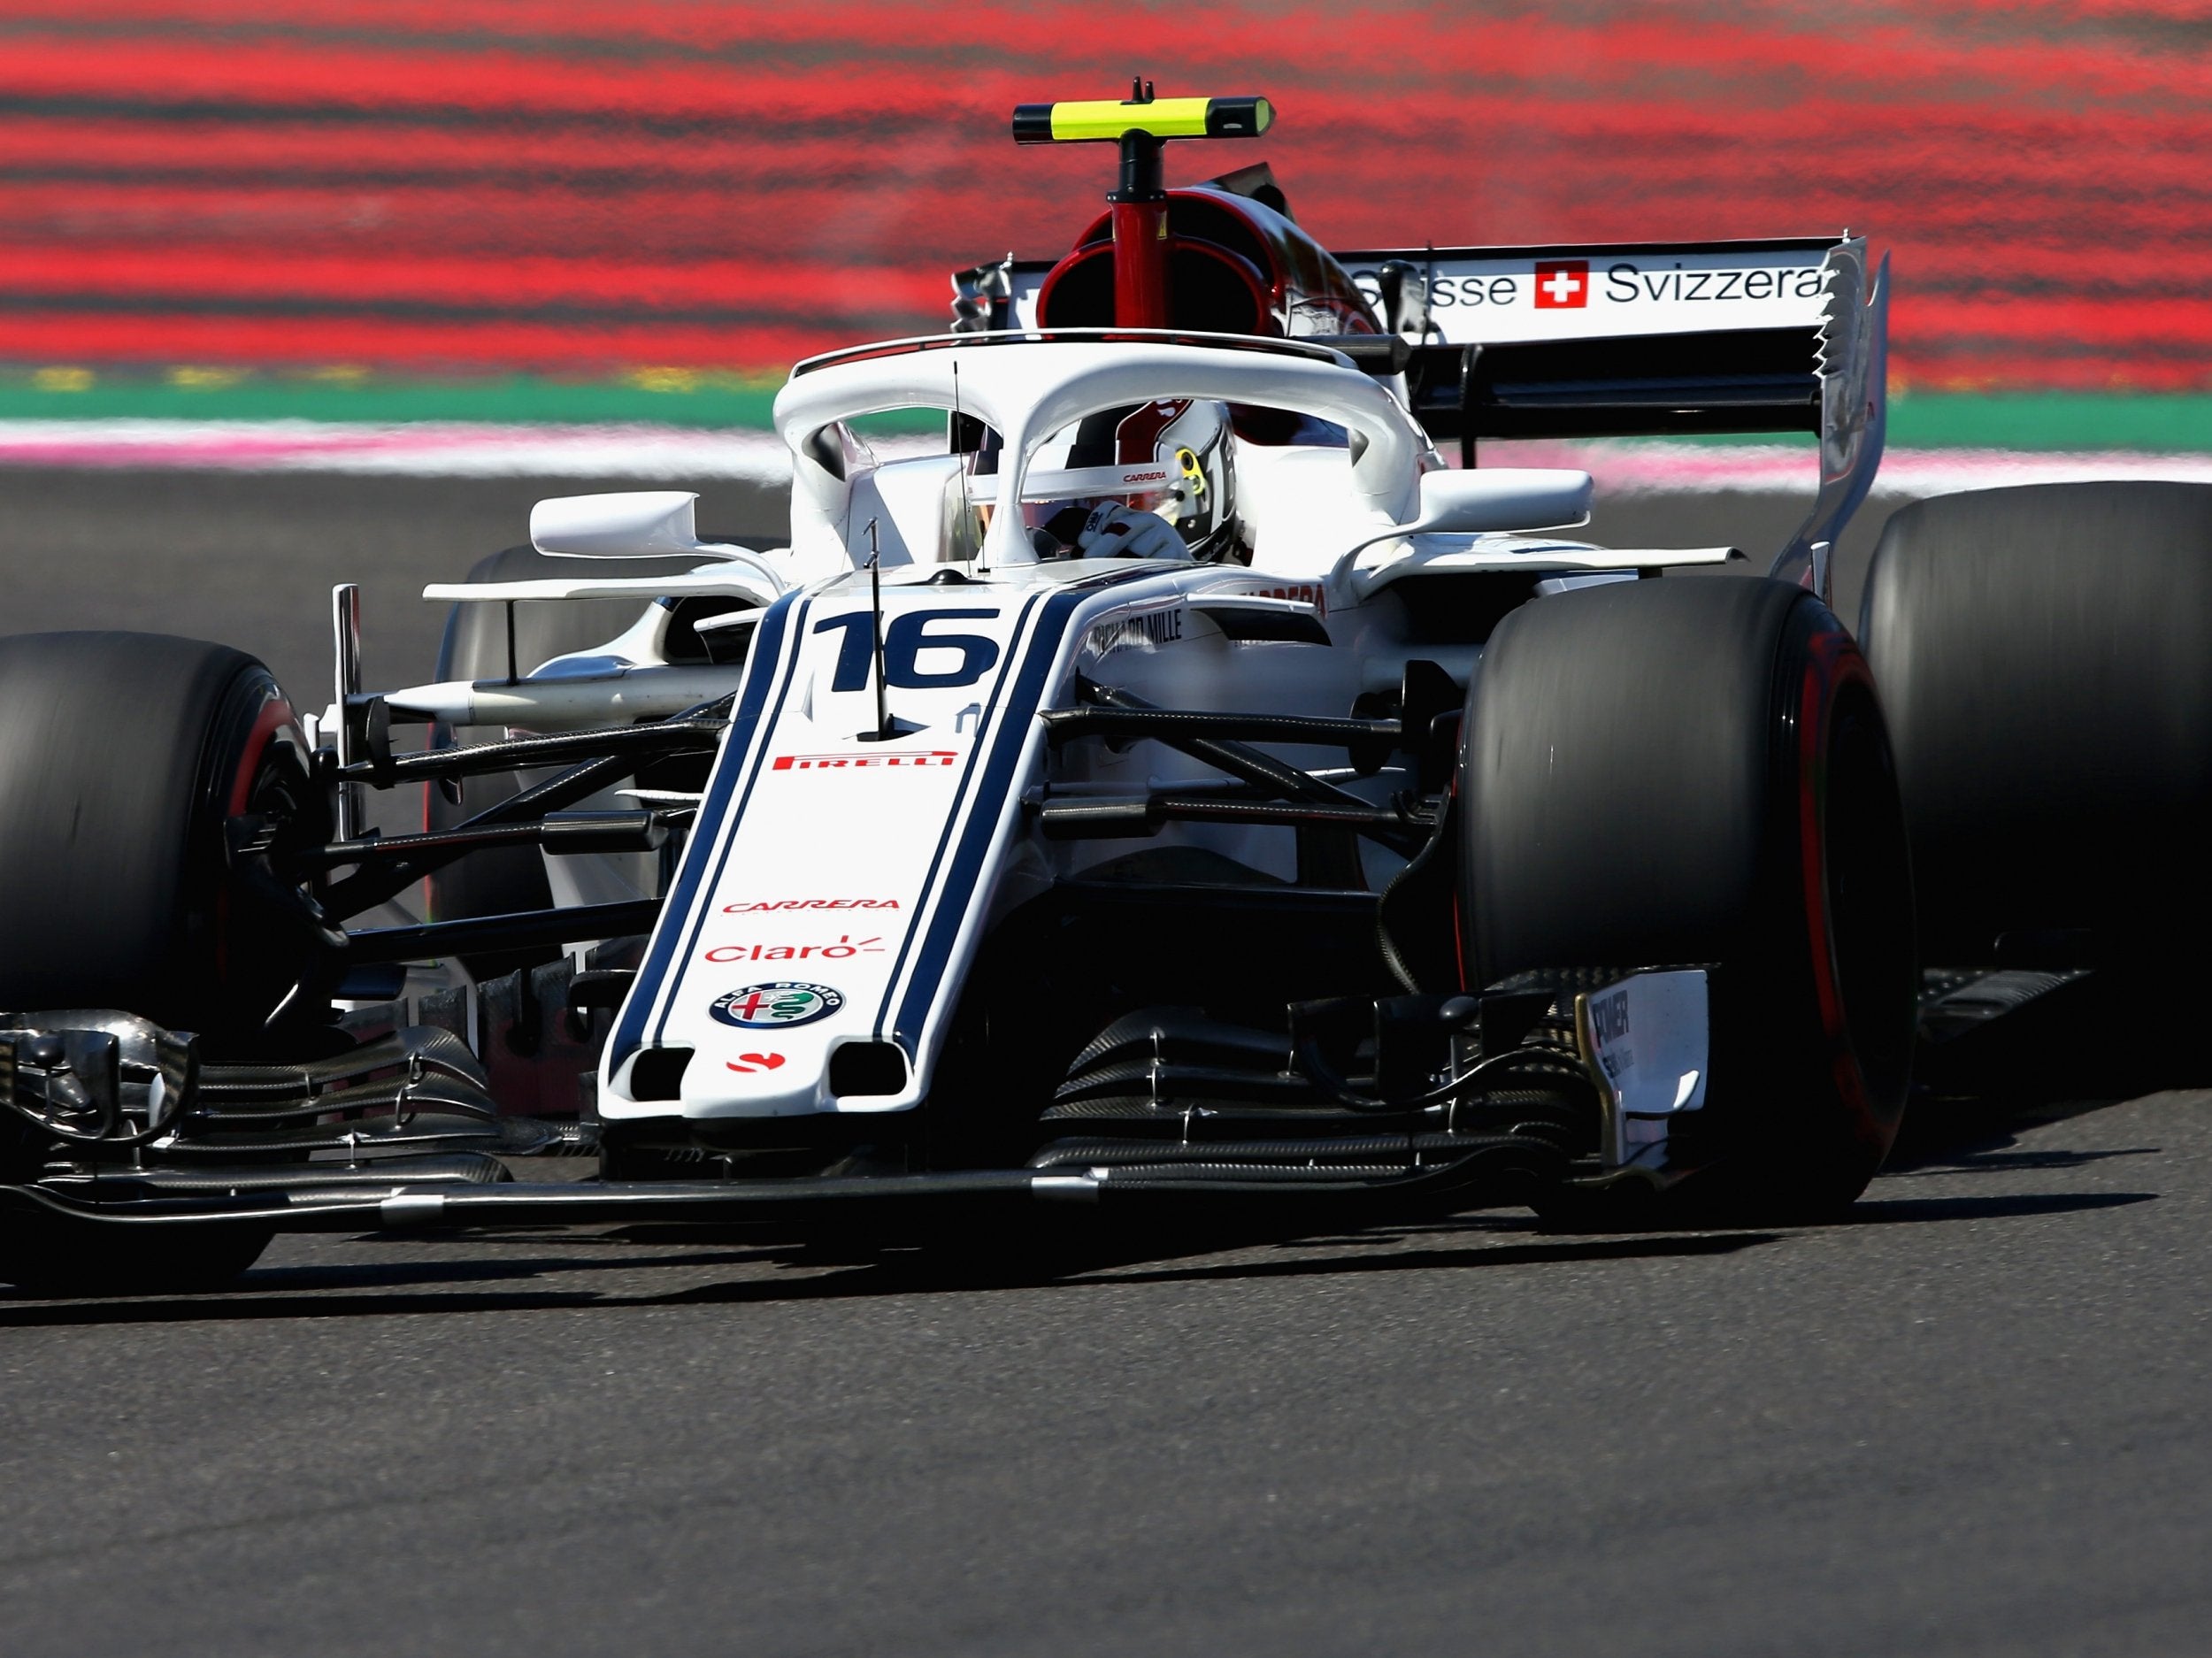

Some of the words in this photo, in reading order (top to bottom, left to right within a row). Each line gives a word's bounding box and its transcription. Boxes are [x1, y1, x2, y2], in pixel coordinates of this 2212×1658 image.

[1606, 262, 1823, 302] Svizzera
[1123, 472, 1166, 482] CARRERA
[1147, 609, 1182, 643] MILLE
[812, 608, 1001, 692] 16
[772, 751, 958, 771] PIRELLI
[723, 899, 900, 913] CARRERA
[704, 937, 860, 963] Claro
[714, 986, 763, 1009] ALFA
[774, 982, 841, 1006] ROMEO
